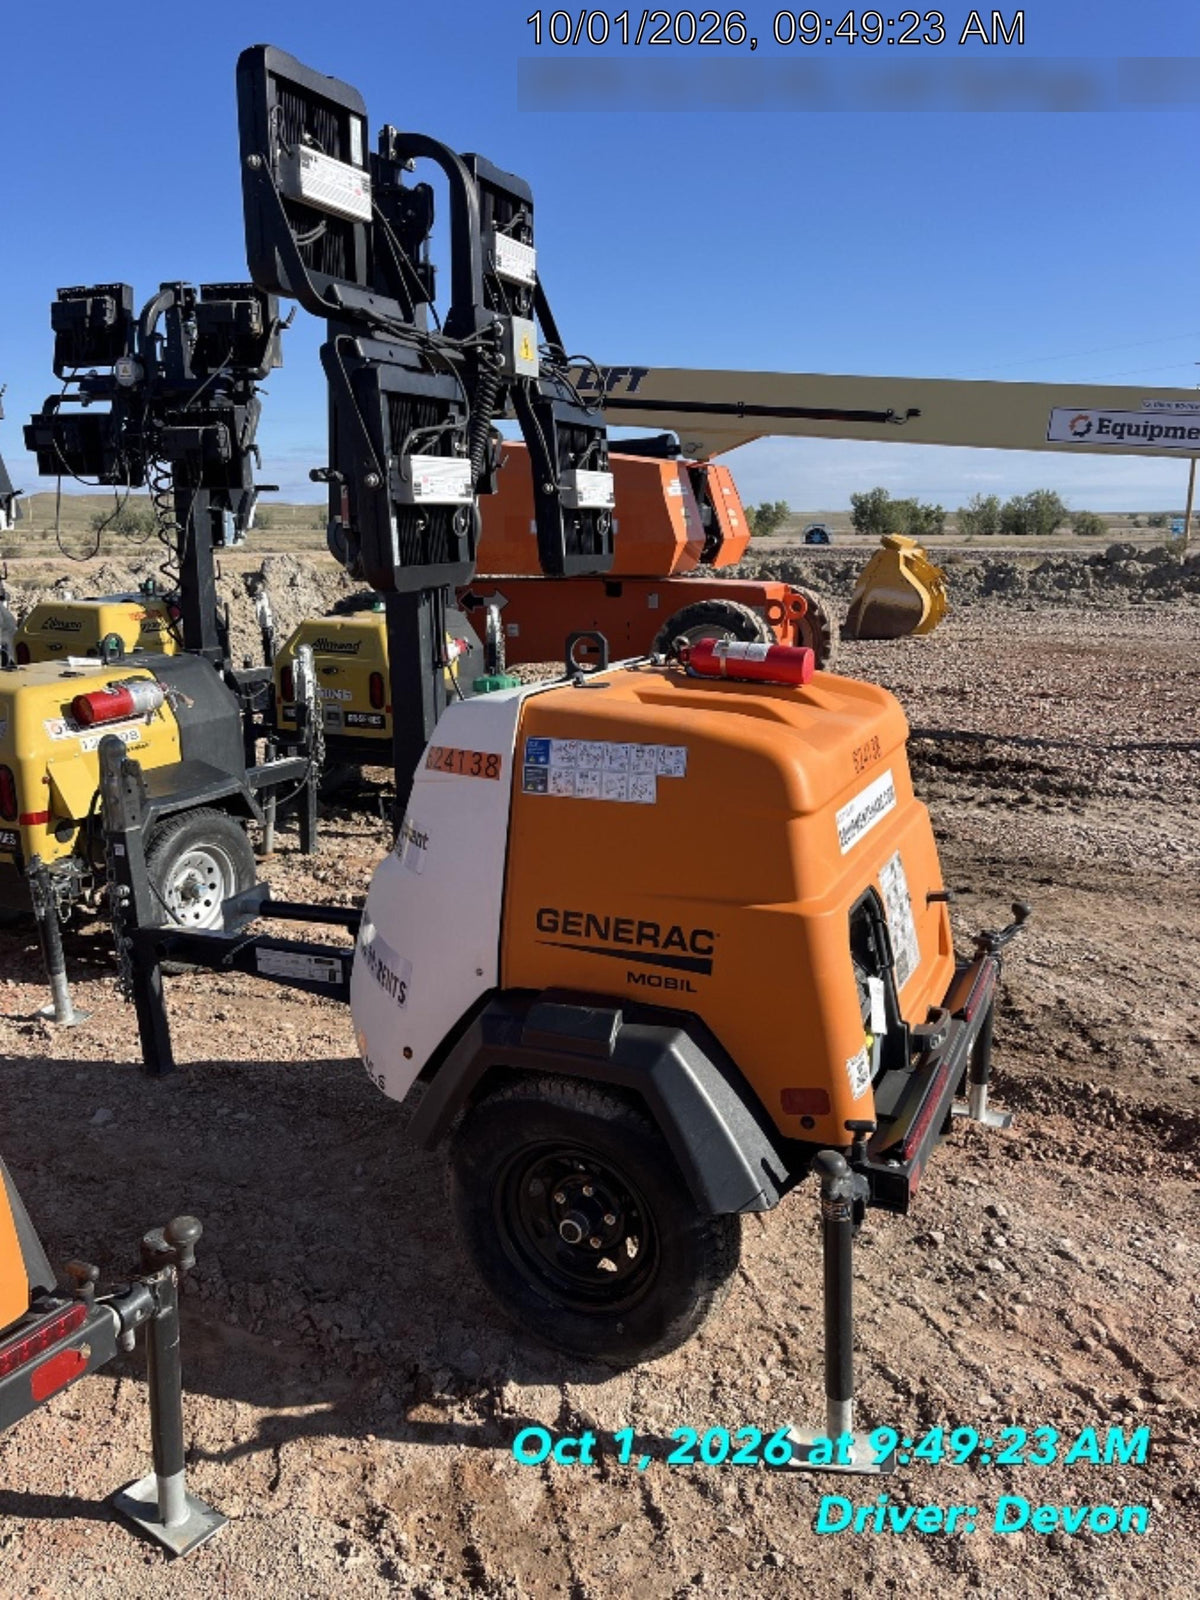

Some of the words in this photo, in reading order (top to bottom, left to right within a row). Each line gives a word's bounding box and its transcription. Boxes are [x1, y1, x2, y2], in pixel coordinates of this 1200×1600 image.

[1096, 417, 1200, 441] Equipme
[536, 907, 714, 955] GENERAC
[627, 971, 698, 993] MOBIL
